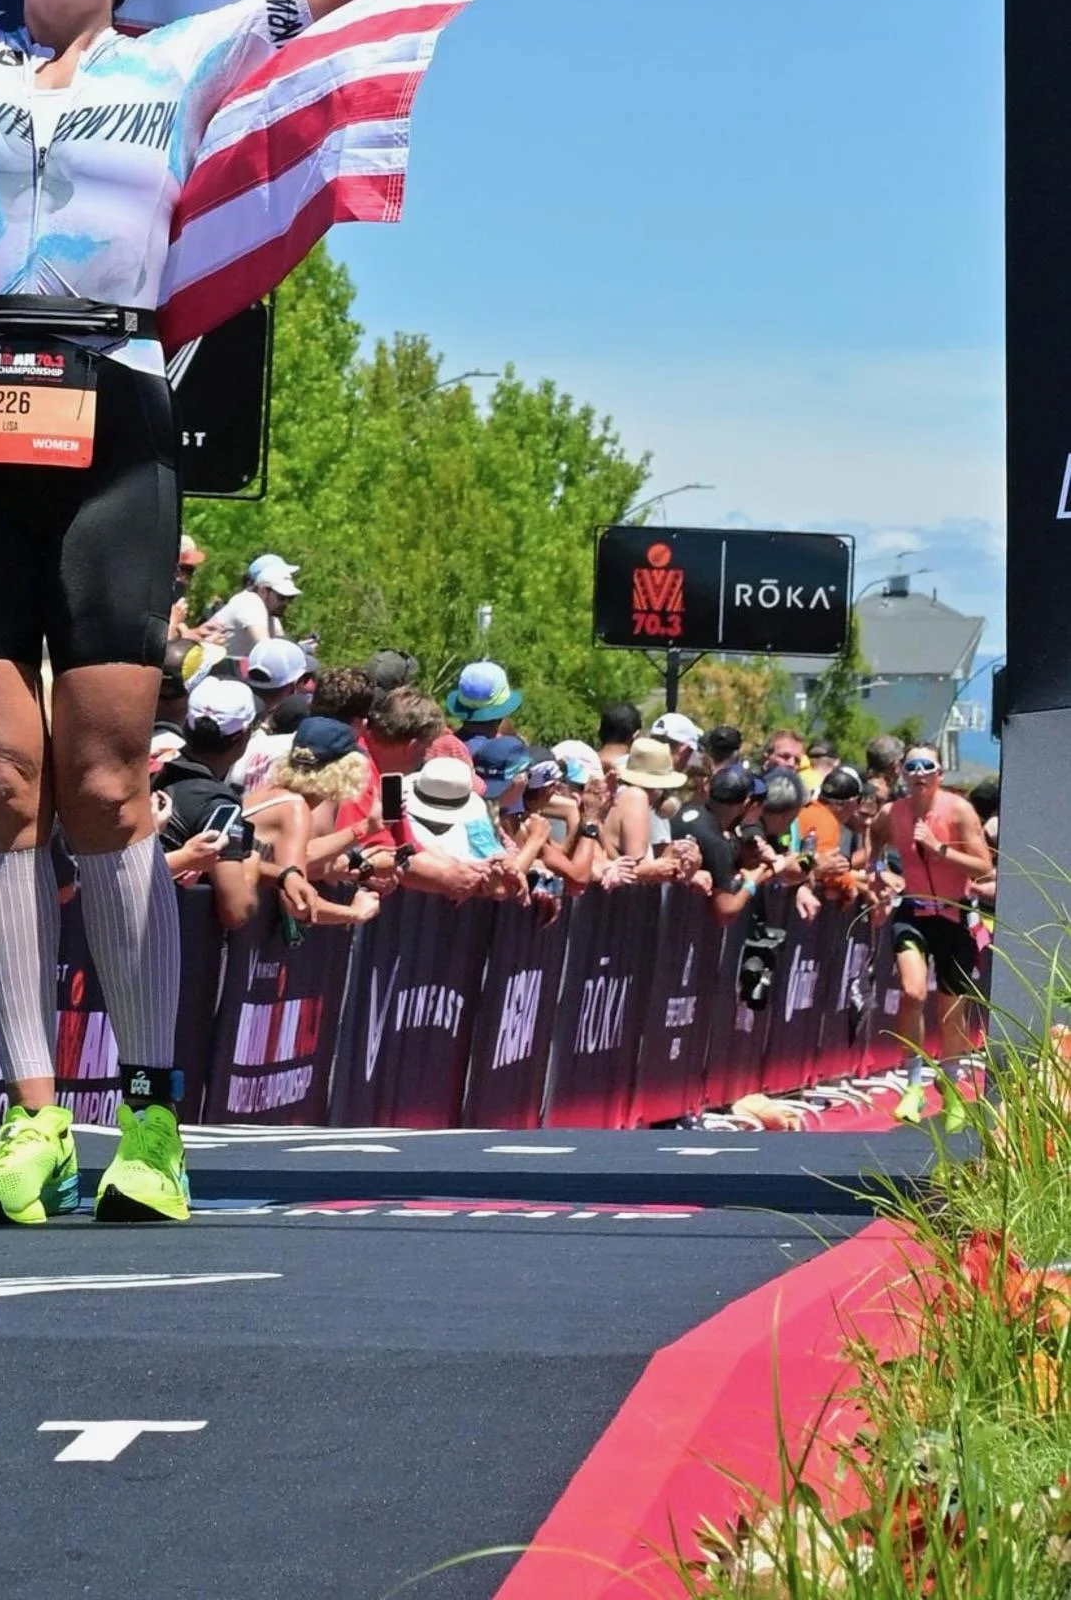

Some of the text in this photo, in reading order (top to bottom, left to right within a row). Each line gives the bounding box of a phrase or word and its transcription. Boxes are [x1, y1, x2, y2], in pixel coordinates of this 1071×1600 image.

[2, 421, 19, 432] LISA
[32, 438, 79, 451] WOMEN
[632, 613, 684, 637] 70.3
[395, 985, 465, 1038] VINFAST
